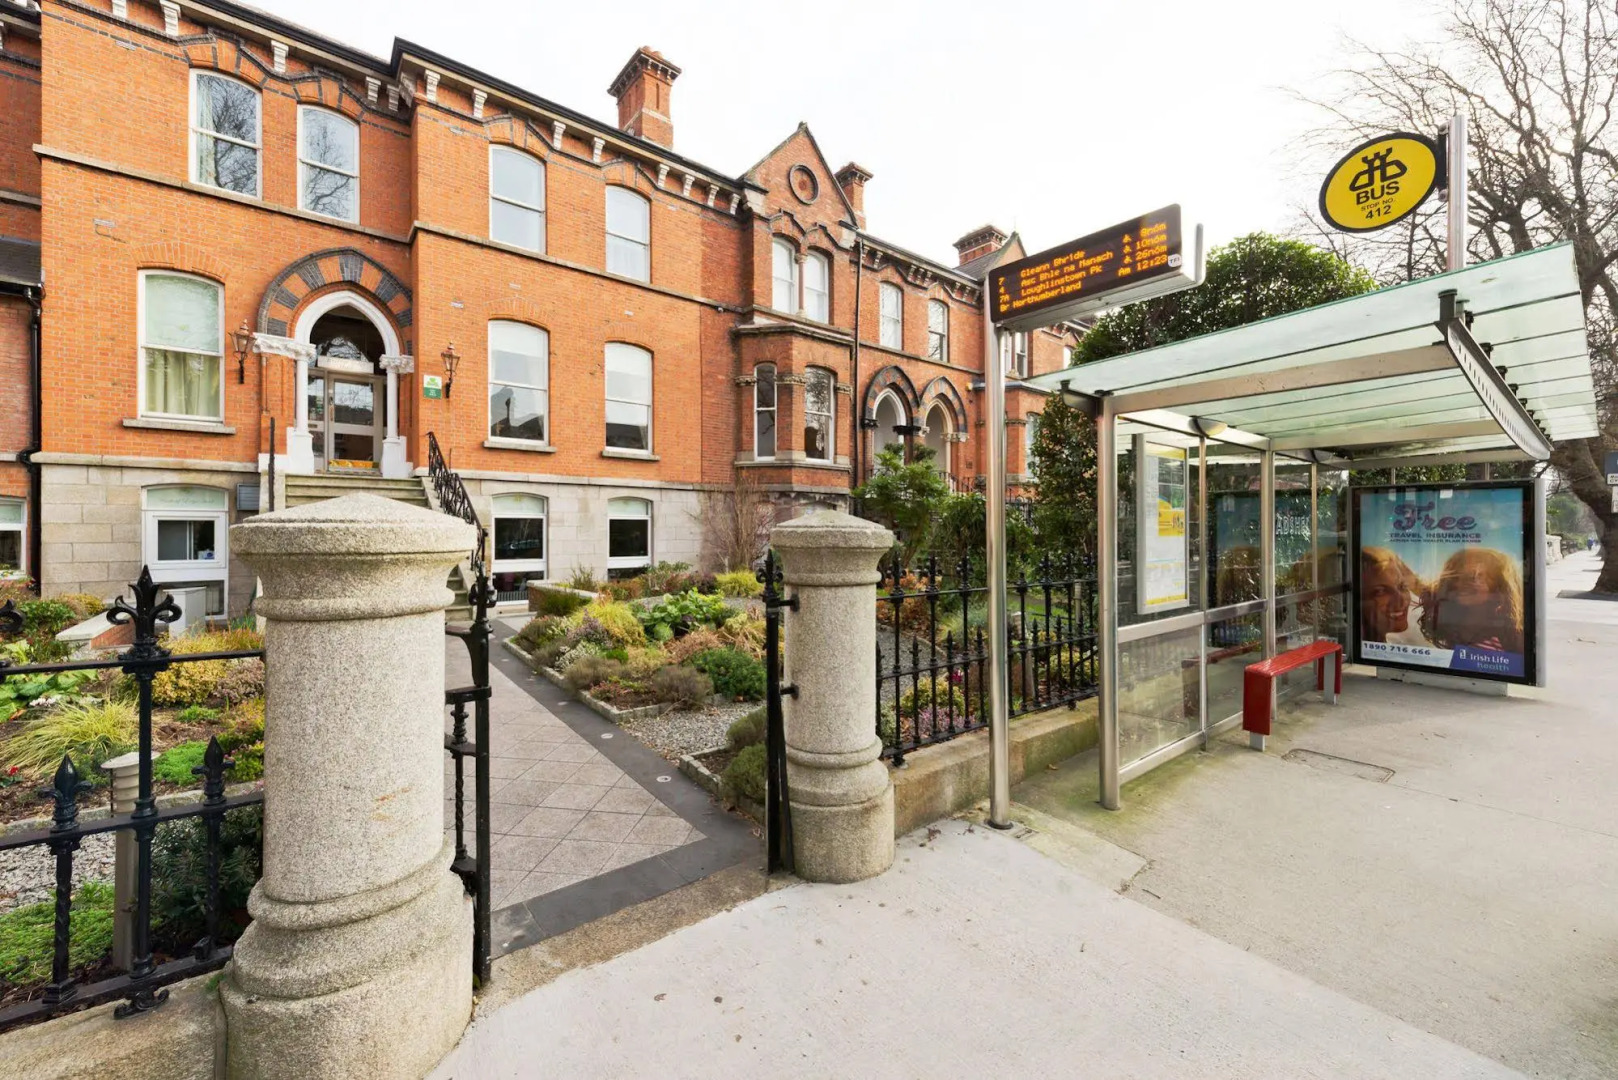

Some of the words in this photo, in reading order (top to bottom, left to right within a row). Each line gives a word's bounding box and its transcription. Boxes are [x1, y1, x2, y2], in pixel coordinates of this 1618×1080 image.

[1356, 181, 1400, 205] BUS
[1361, 202, 1380, 211] STOP
[1365, 204, 1392, 219] 412
[998, 277, 1006, 286] 7
[1020, 262, 1051, 278] Gleann
[1053, 249, 1086, 267] Bhride
[1063, 264, 1076, 273] na
[1013, 280, 1082, 308] Northumberland
[1136, 254, 1168, 271] 12:23
[1021, 270, 1086, 297] Loughlinstown
[1393, 501, 1478, 531] Free
[1363, 642, 1387, 651] 1890
[1470, 653, 1491, 662] Irish
[1492, 654, 1510, 664] Life
[1477, 662, 1510, 671] health
